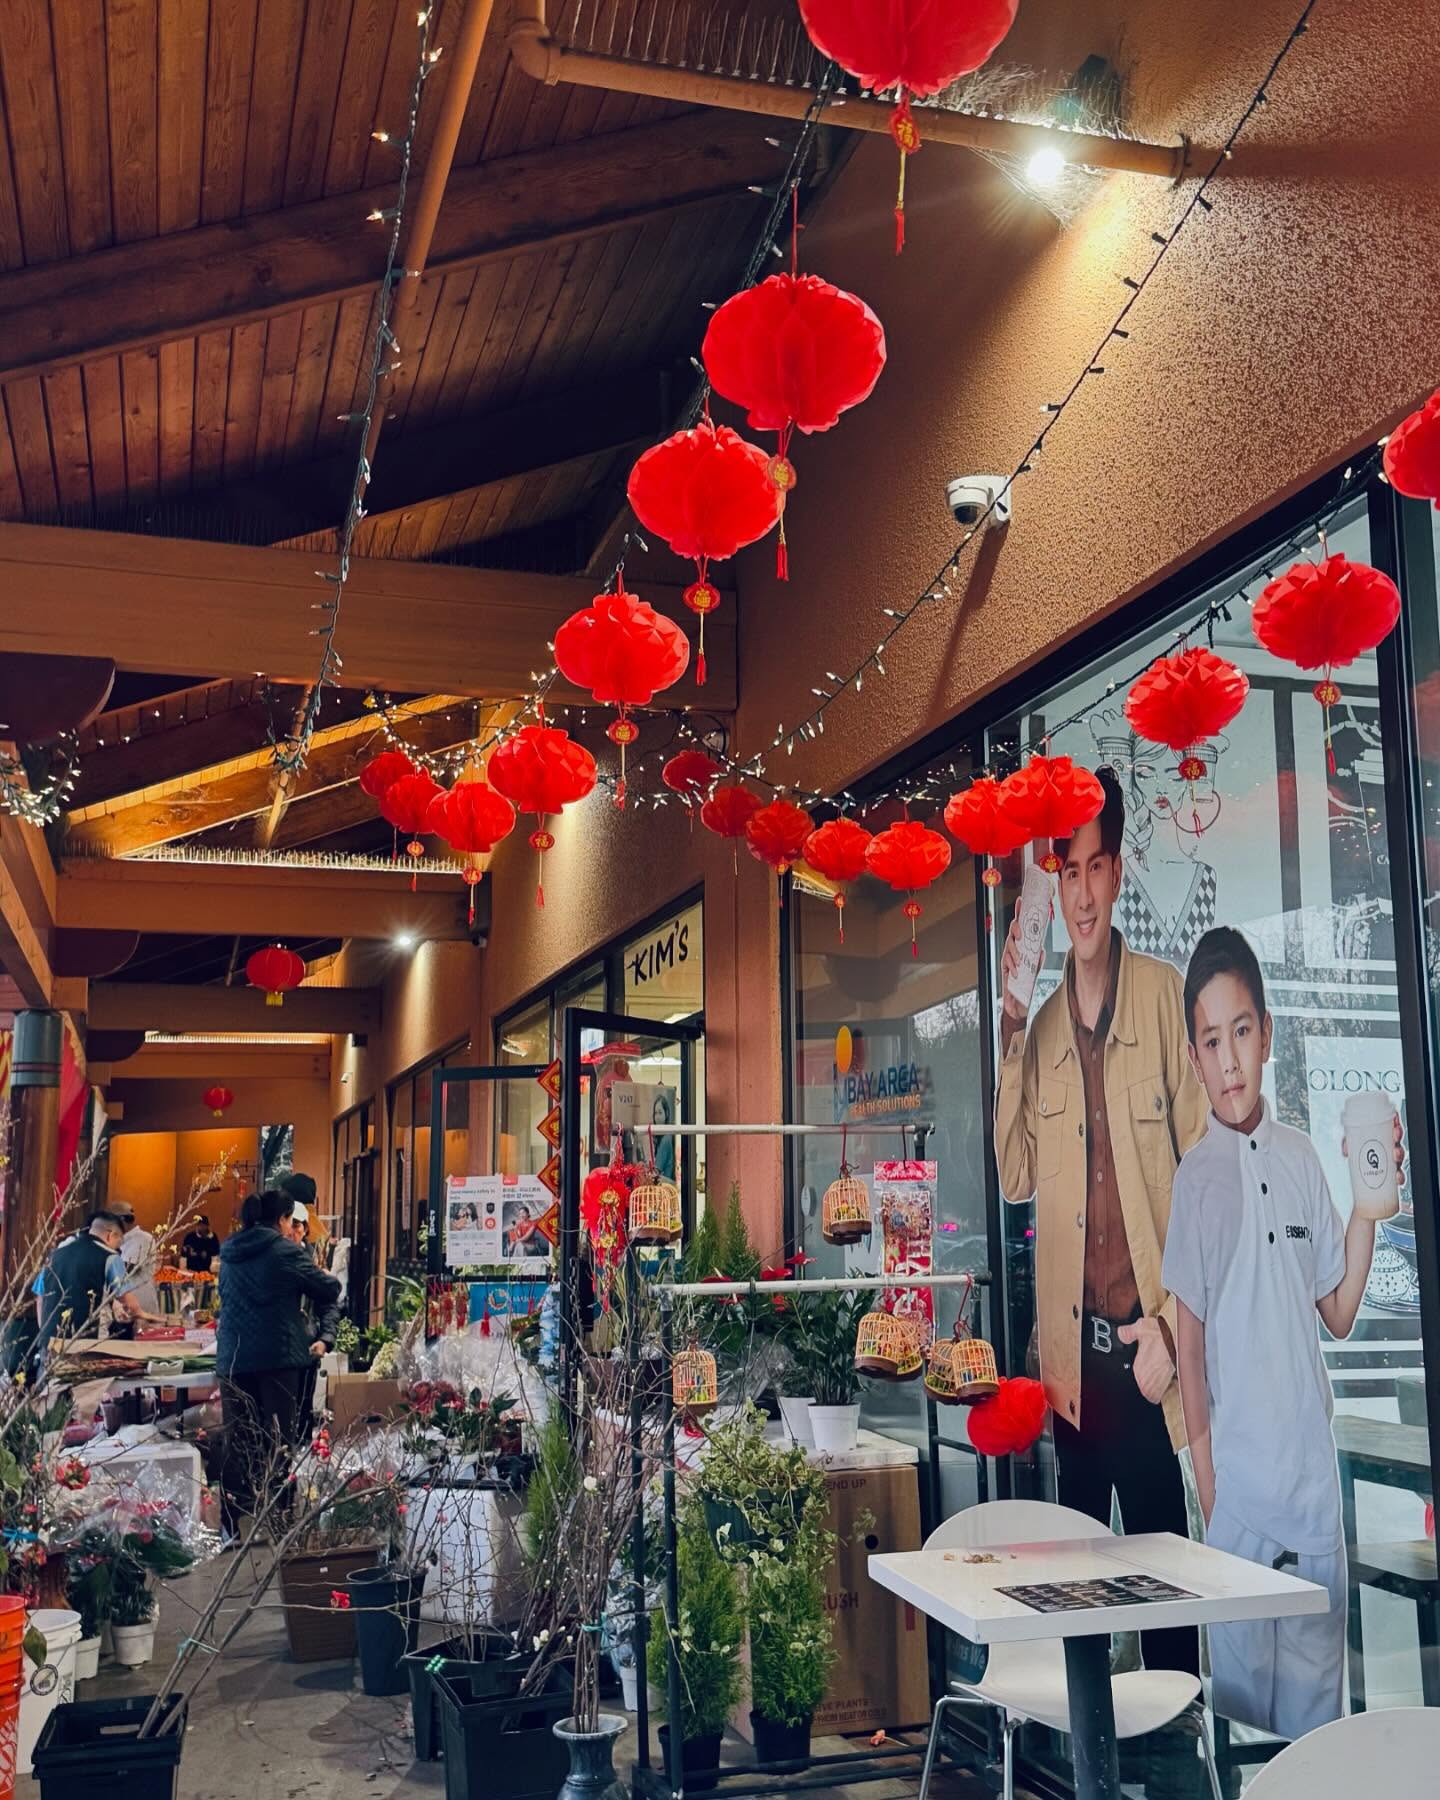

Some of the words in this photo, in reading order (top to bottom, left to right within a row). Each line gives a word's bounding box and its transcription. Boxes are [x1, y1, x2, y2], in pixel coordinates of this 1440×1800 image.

[1321, 686, 1334, 702] 福
[1186, 759, 1201, 777] 福
[626, 919, 689, 986] KIM'S
[847, 1071, 874, 1104] BAY
[877, 1062, 920, 1098] AREA
[1308, 1067, 1402, 1093] OLONG
[1091, 1316, 1112, 1353] B
[822, 1479, 849, 1489] END
[851, 1479, 866, 1489] UP
